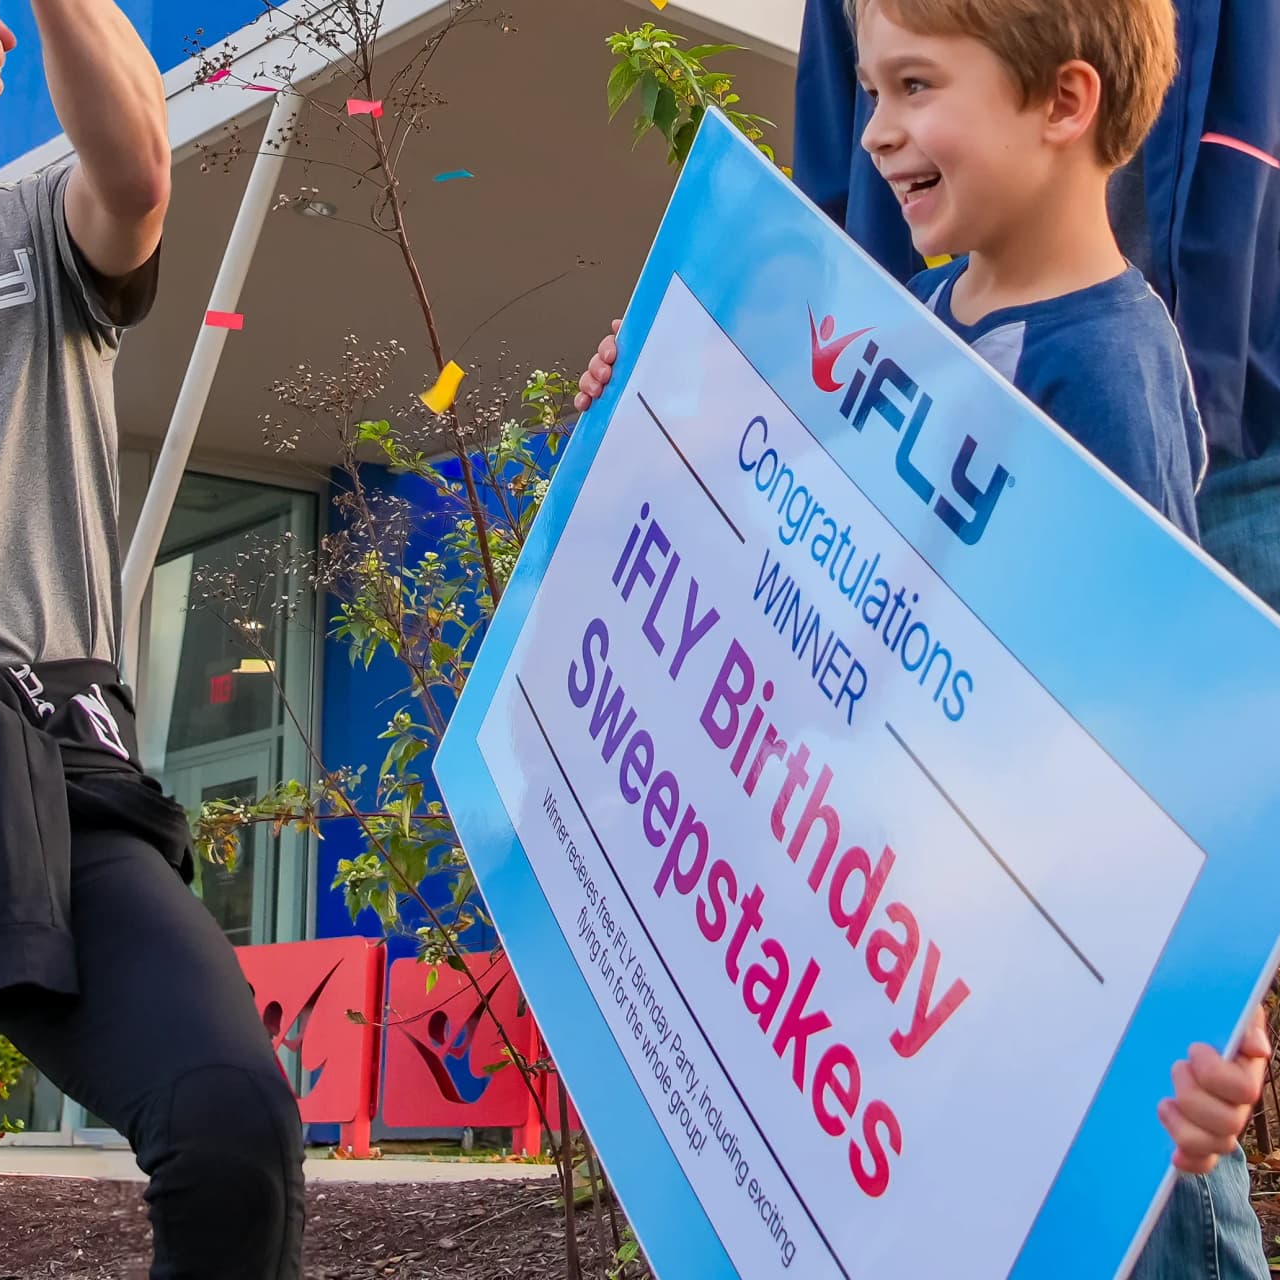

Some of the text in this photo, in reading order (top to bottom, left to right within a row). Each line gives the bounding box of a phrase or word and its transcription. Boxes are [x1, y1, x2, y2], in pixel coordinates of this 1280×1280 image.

[738, 415, 973, 722] Congratulations
[838, 337, 1010, 546] iFLY
[612, 502, 971, 1059] iFLY Birthday
[753, 548, 868, 726] WINNER
[542, 786, 797, 1269] Winner recieves free iFLY Birthday Party, including exciting
[567, 617, 902, 1197] Sweepstakes
[576, 905, 708, 1157] flying fun for the whole group!
